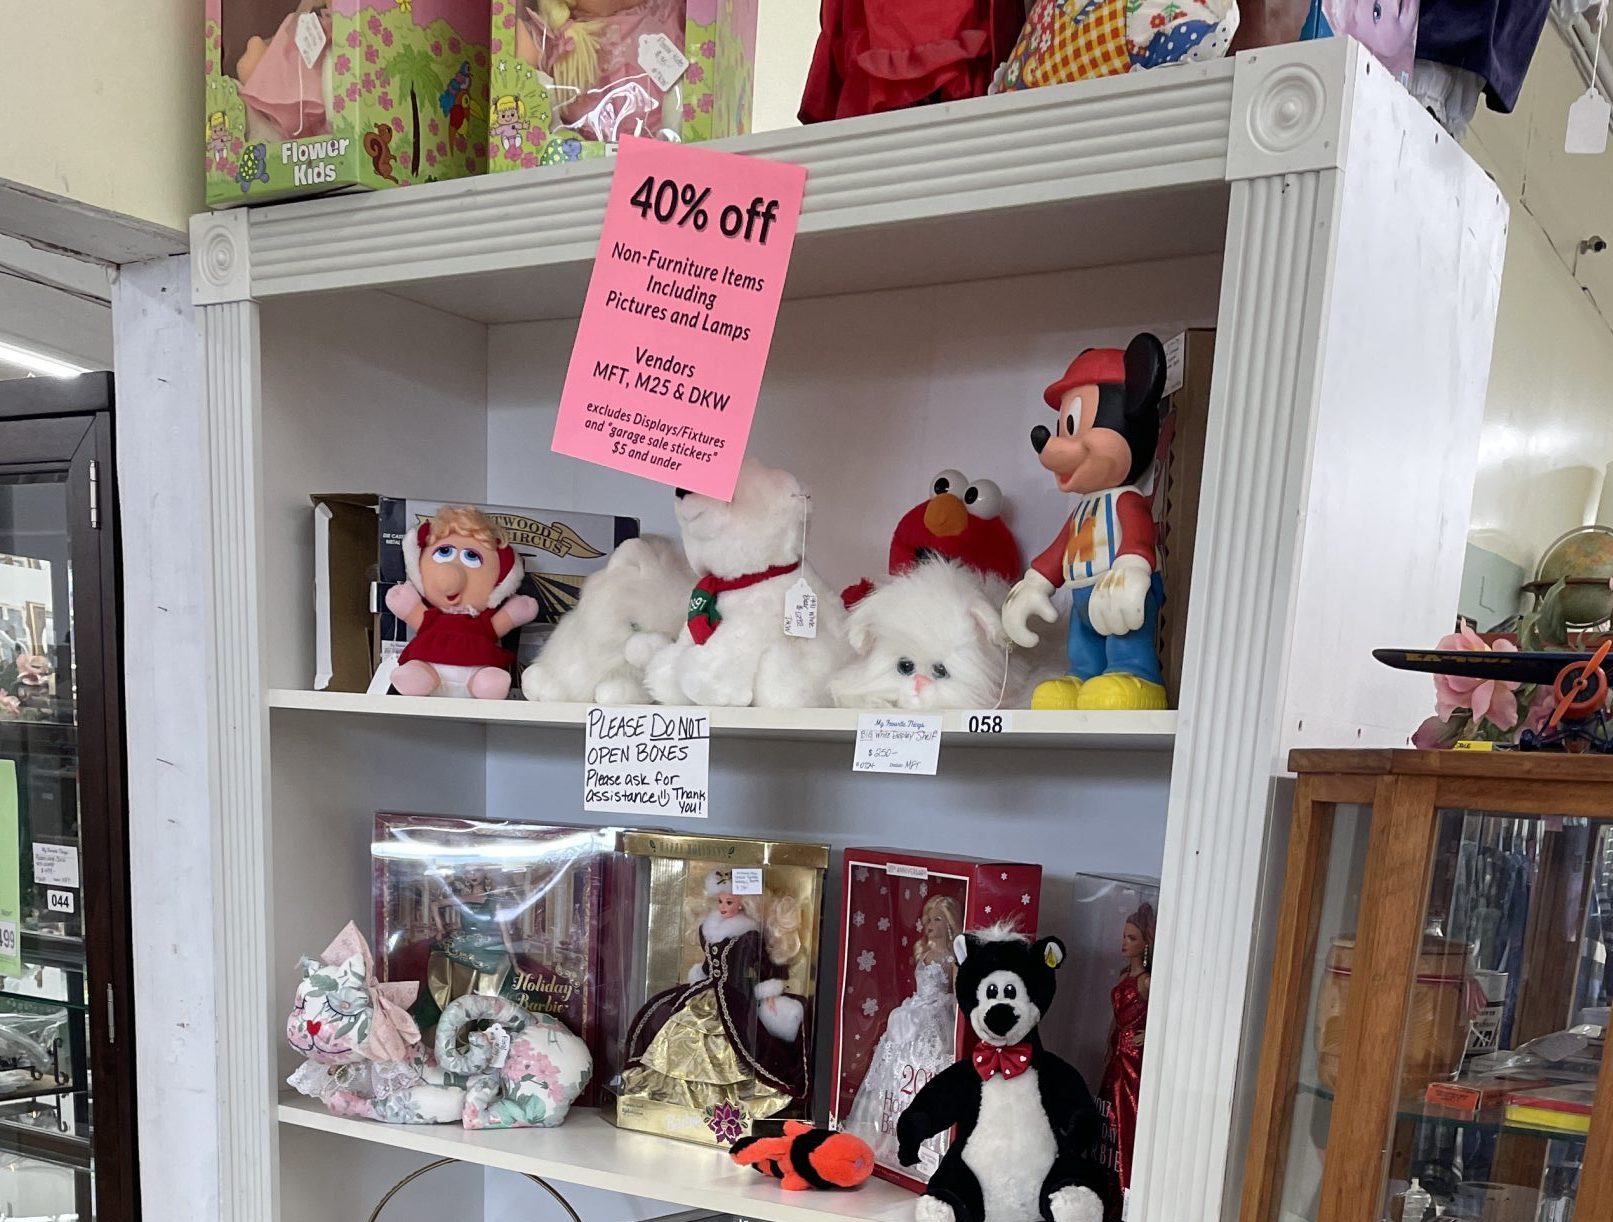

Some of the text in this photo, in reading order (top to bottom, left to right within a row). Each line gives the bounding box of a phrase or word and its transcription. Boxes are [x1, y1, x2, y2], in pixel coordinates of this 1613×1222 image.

[281, 138, 350, 164] Flower
[294, 161, 337, 186] Kids
[630, 176, 779, 244] 40% off
[612, 241, 764, 292] Non-Furniture Items
[646, 275, 717, 310] Including
[605, 290, 751, 341] Pictures and Lamps
[635, 346, 696, 377] Vendors
[593, 361, 731, 412] MFT, M25 & DKW
[584, 418, 718, 463] and "garage sale stickers"
[587, 402, 726, 449] excludes Displays/Fixtures
[611, 440, 683, 471] $5 and under
[489, 515, 552, 539] TWOOD
[588, 708, 647, 739] PLEASE
[678, 716, 707, 739] NOT
[969, 715, 1003, 733] 058
[587, 743, 689, 765] OPEN BOXES
[586, 769, 680, 787] Please ask for
[585, 787, 706, 804] assistance Thank
[51, 894, 69, 908] 044
[512, 972, 573, 1001] Holiday
[517, 993, 565, 1013] Barbie
